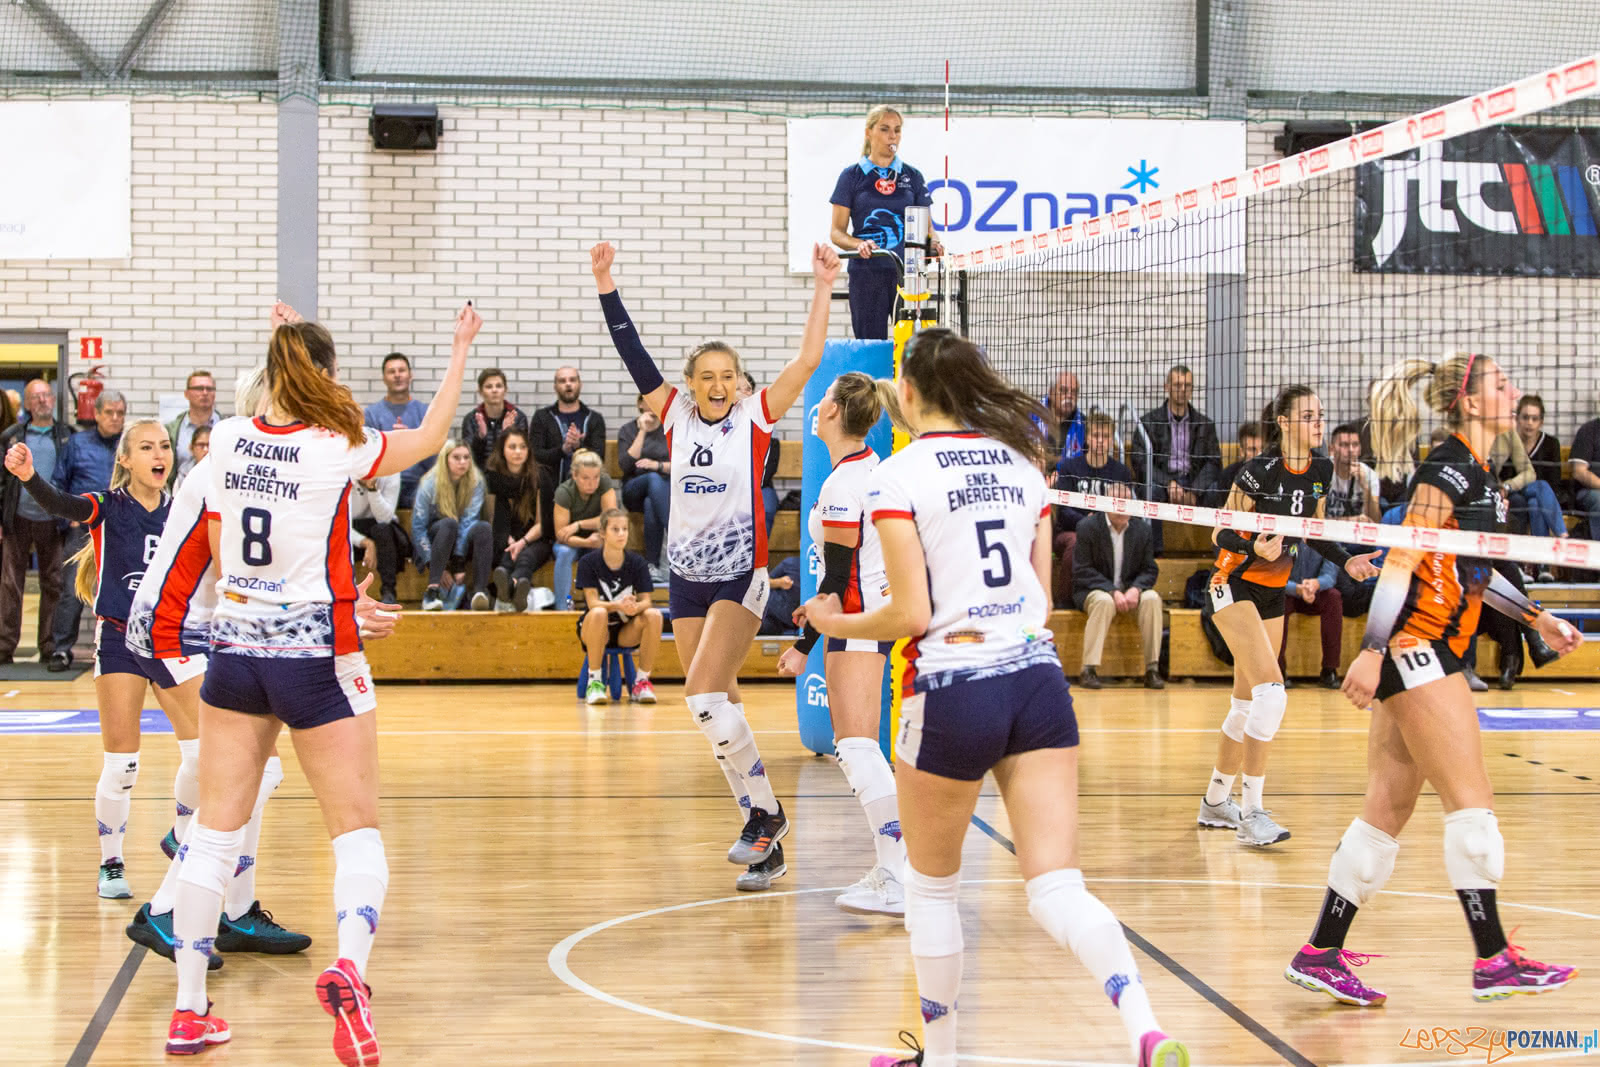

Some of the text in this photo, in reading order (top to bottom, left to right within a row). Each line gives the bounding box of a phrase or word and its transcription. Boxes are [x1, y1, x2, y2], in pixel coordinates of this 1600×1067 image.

[234, 438, 301, 463] PASZNIK
[246, 464, 277, 479] ENEA
[965, 472, 999, 487] ENEA
[225, 471, 300, 501] ENERGETYK
[684, 482, 727, 494] Enea
[947, 485, 1025, 513] ENERGETYK
[1290, 489, 1305, 516] 8
[242, 506, 273, 566] 8
[975, 519, 1012, 588] 5
[1215, 585, 1225, 600] 8
[1400, 651, 1431, 671] 16
[353, 676, 368, 694] 8
